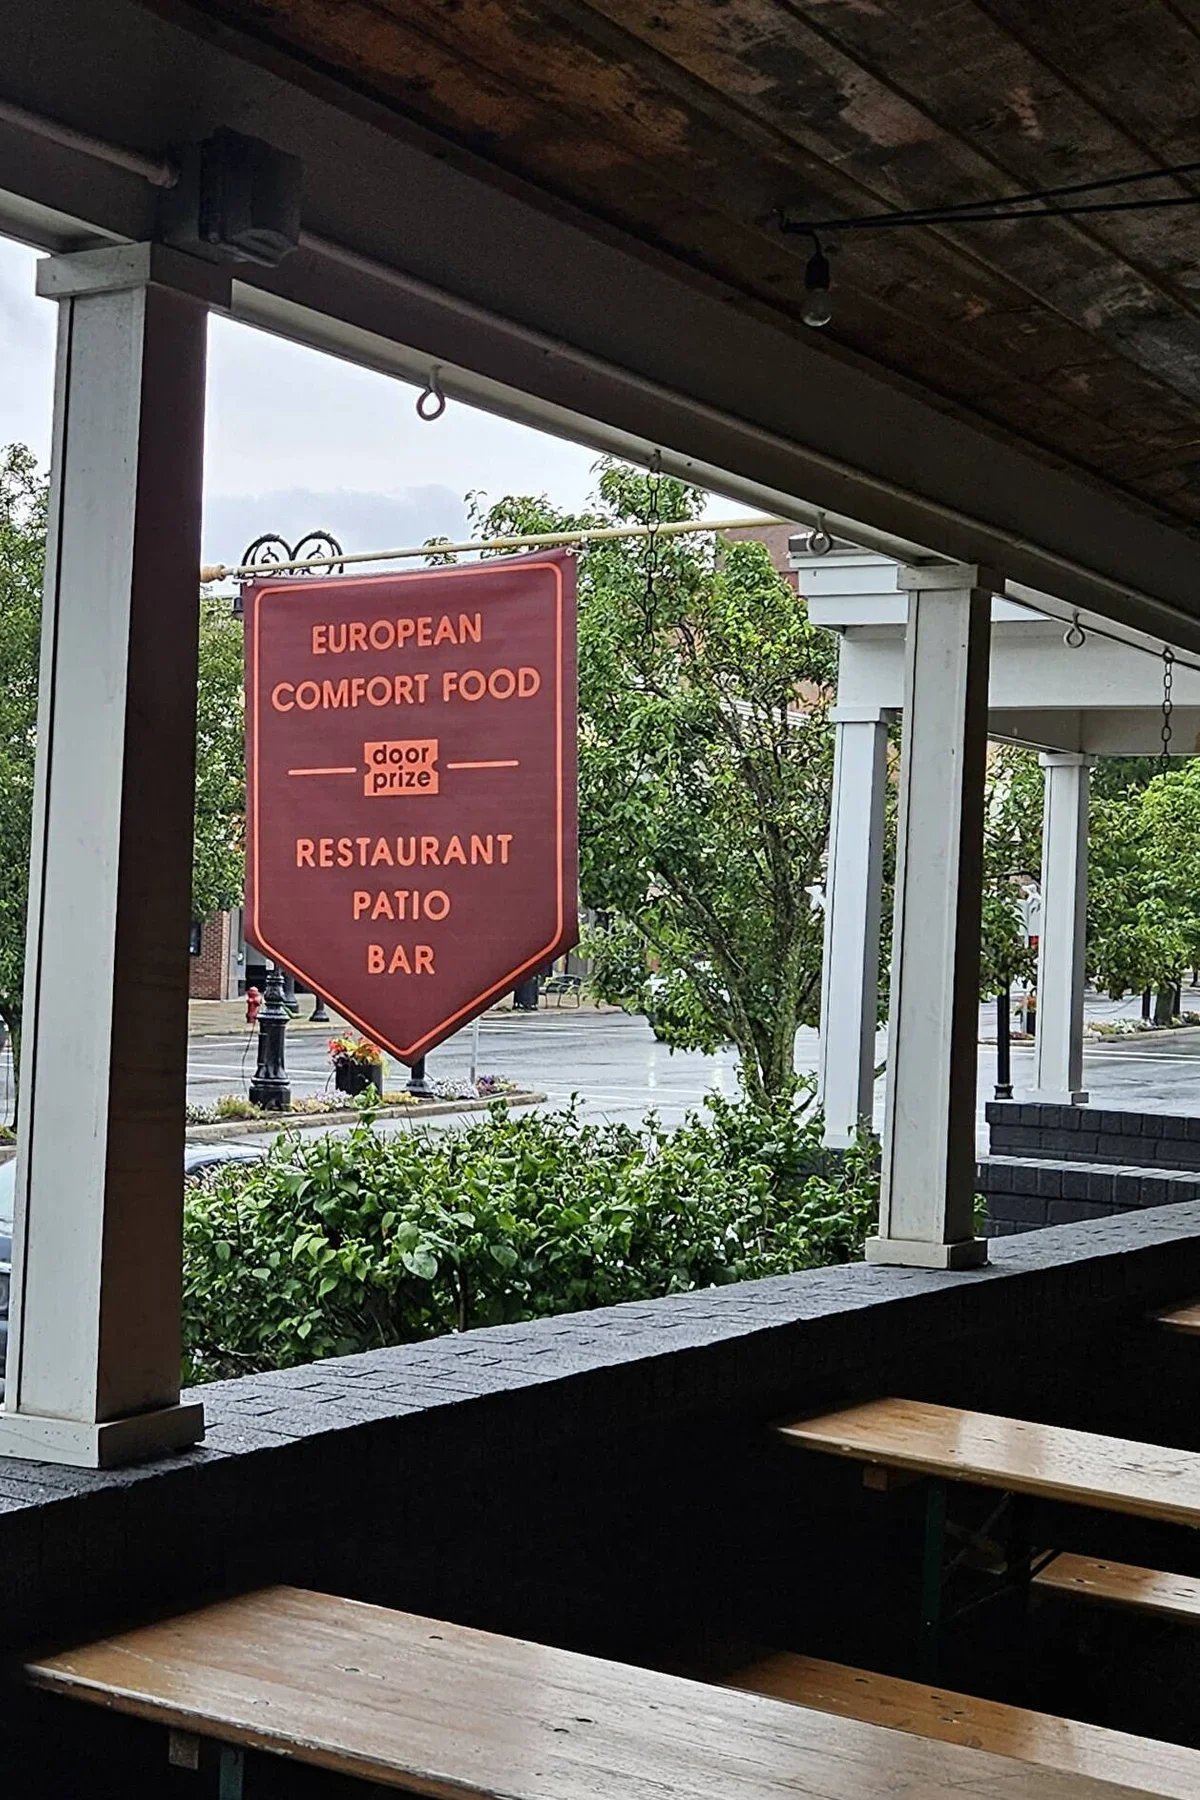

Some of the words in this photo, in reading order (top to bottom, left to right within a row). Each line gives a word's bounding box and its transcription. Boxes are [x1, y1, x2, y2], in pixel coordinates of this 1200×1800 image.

[312, 612, 482, 655] EUROPEAN
[271, 673, 430, 712] COMFORT
[442, 667, 541, 702] FOOD
[372, 744, 429, 765] door
[373, 765, 431, 794] prize
[296, 834, 513, 868] RESTAURANT
[353, 890, 451, 920] PATIO
[367, 944, 435, 974] BAR
